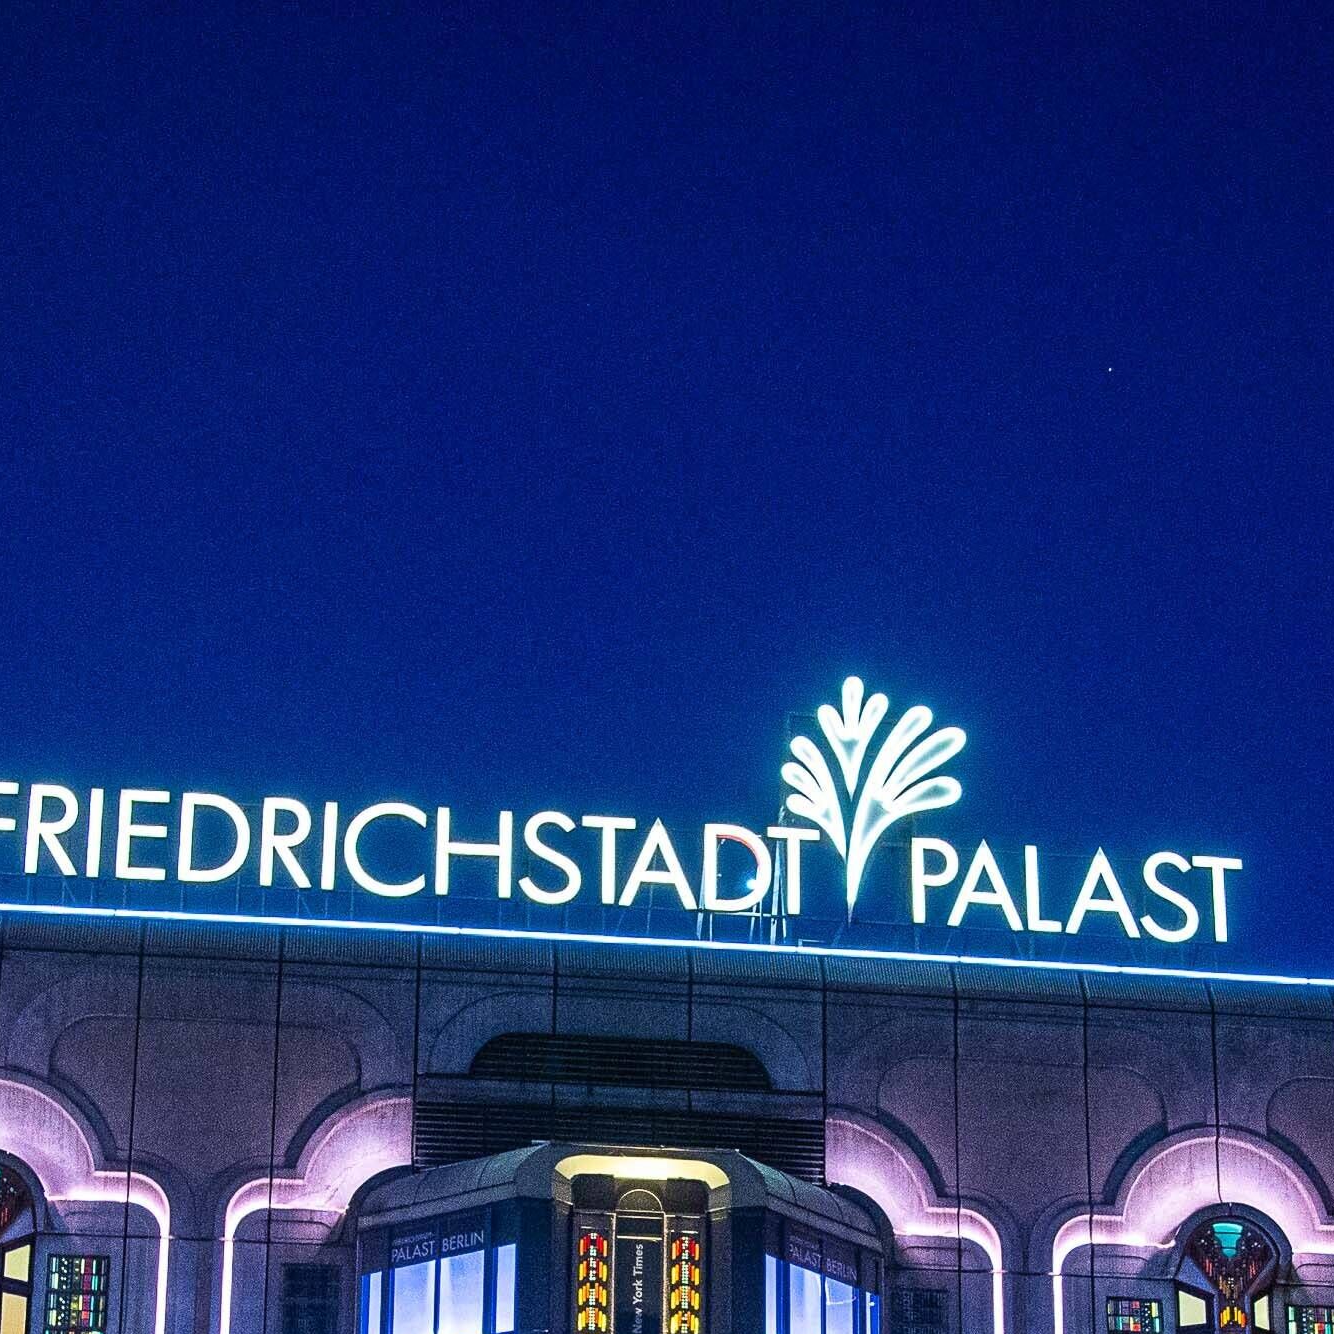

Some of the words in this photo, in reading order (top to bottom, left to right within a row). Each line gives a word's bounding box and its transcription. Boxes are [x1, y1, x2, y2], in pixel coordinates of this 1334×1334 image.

[911, 836, 1243, 943] PALAST
[391, 1241, 435, 1262] PALAST
[442, 1230, 484, 1252] BERLIN
[633, 1244, 643, 1276] Times
[632, 1280, 643, 1304] York
[632, 1308, 643, 1334] New
